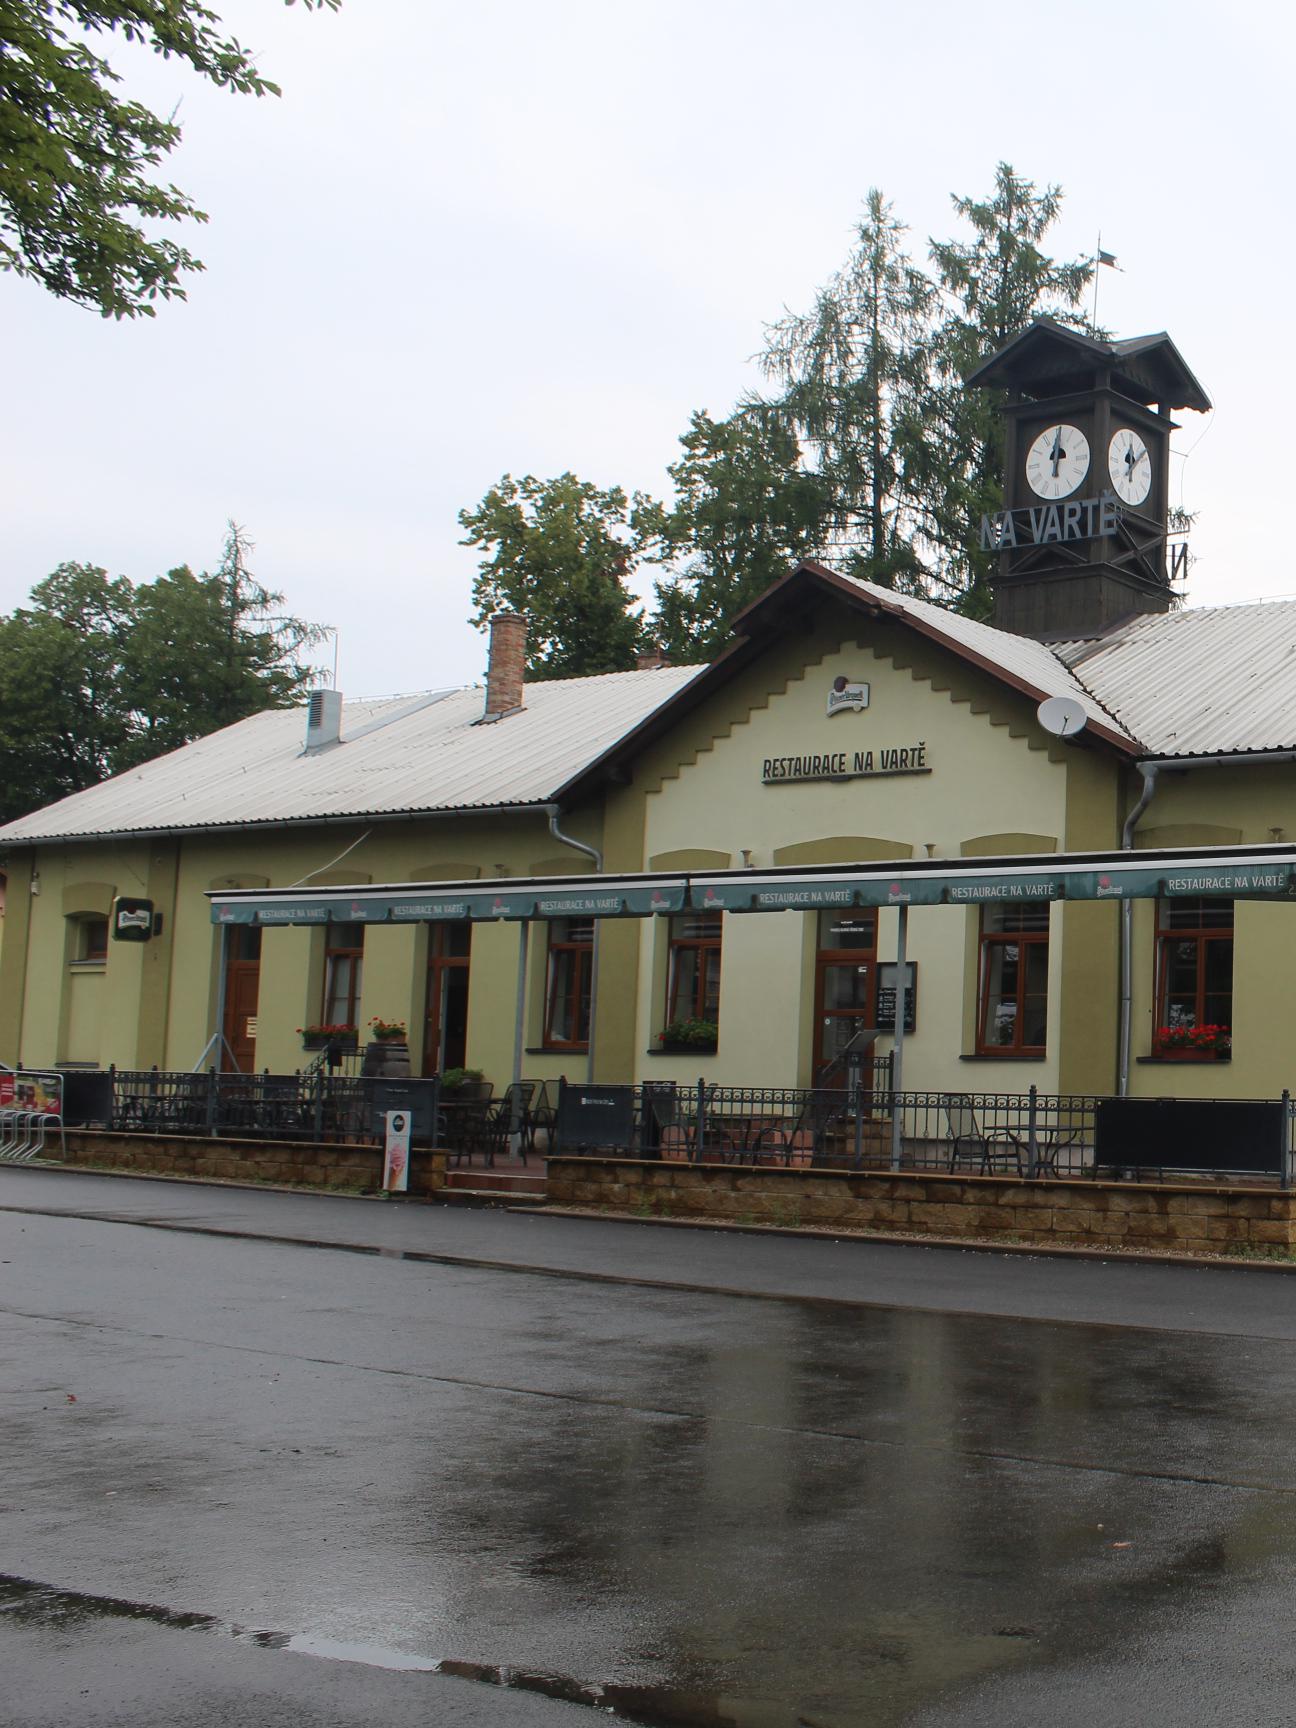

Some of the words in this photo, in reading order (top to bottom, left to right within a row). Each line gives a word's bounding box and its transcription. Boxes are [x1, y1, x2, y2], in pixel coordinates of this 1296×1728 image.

[981, 510, 1017, 551] NA
[1029, 489, 1117, 545] VARTĚ
[762, 753, 847, 778] RESTAURACE
[853, 751, 874, 772] NA
[880, 741, 927, 770] VARTĚ
[1168, 877, 1231, 890] RESTAURACE
[1234, 876, 1248, 888] NA
[1252, 873, 1284, 887] VARTĚ
[759, 893, 809, 903] RESTAURACE
[811, 892, 823, 901] NA
[951, 886, 1007, 898] RESTAURACE
[1010, 885, 1023, 896] NA
[1025, 882, 1055, 895] VARTĚ
[540, 900, 584, 911] RESTAURACE
[585, 900, 595, 909] NA
